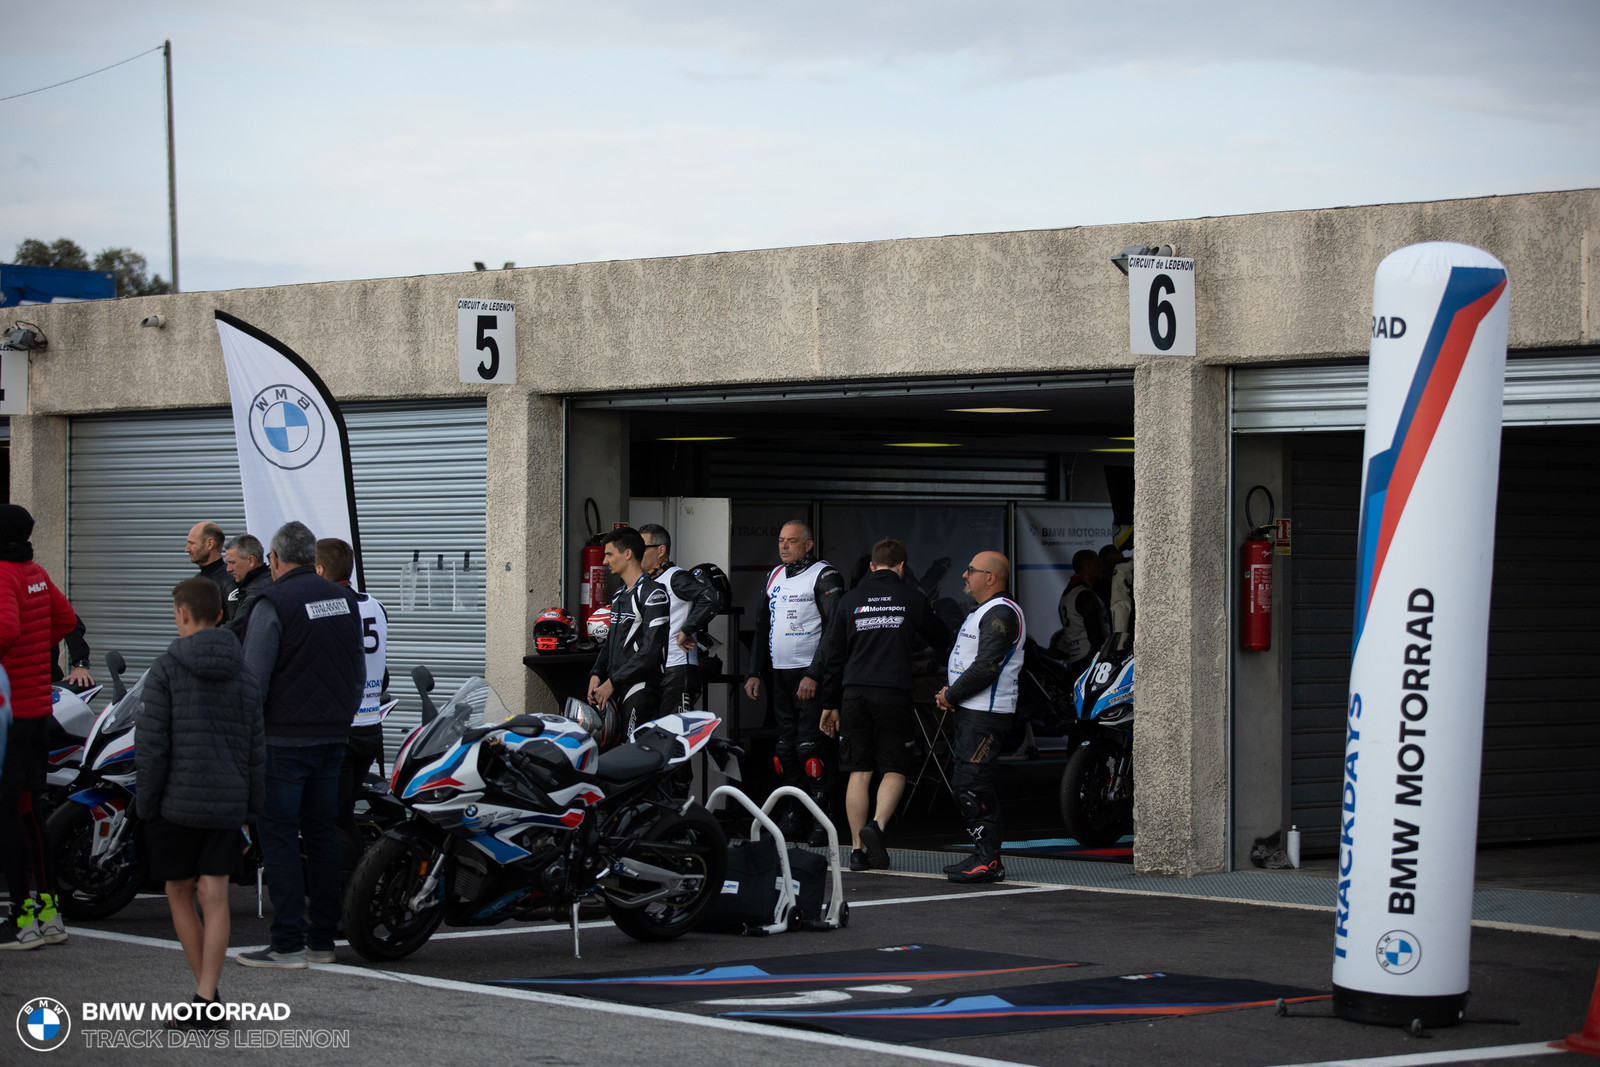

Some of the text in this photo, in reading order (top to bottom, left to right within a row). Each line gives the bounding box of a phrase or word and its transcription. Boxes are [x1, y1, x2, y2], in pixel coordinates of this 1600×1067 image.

[1129, 257, 1194, 271] CIRCUIT de LEDENON
[458, 300, 481, 310] CIRCUIT
[481, 302, 488, 310] de
[1148, 274, 1177, 351] 6
[476, 315, 500, 380] 5
[1041, 527, 1113, 538] BMW MOTORRA
[362, 617, 379, 654] 5
[1387, 587, 1435, 916] BMW MOTORRAD
[1334, 691, 1362, 964] TRACKDAYS
